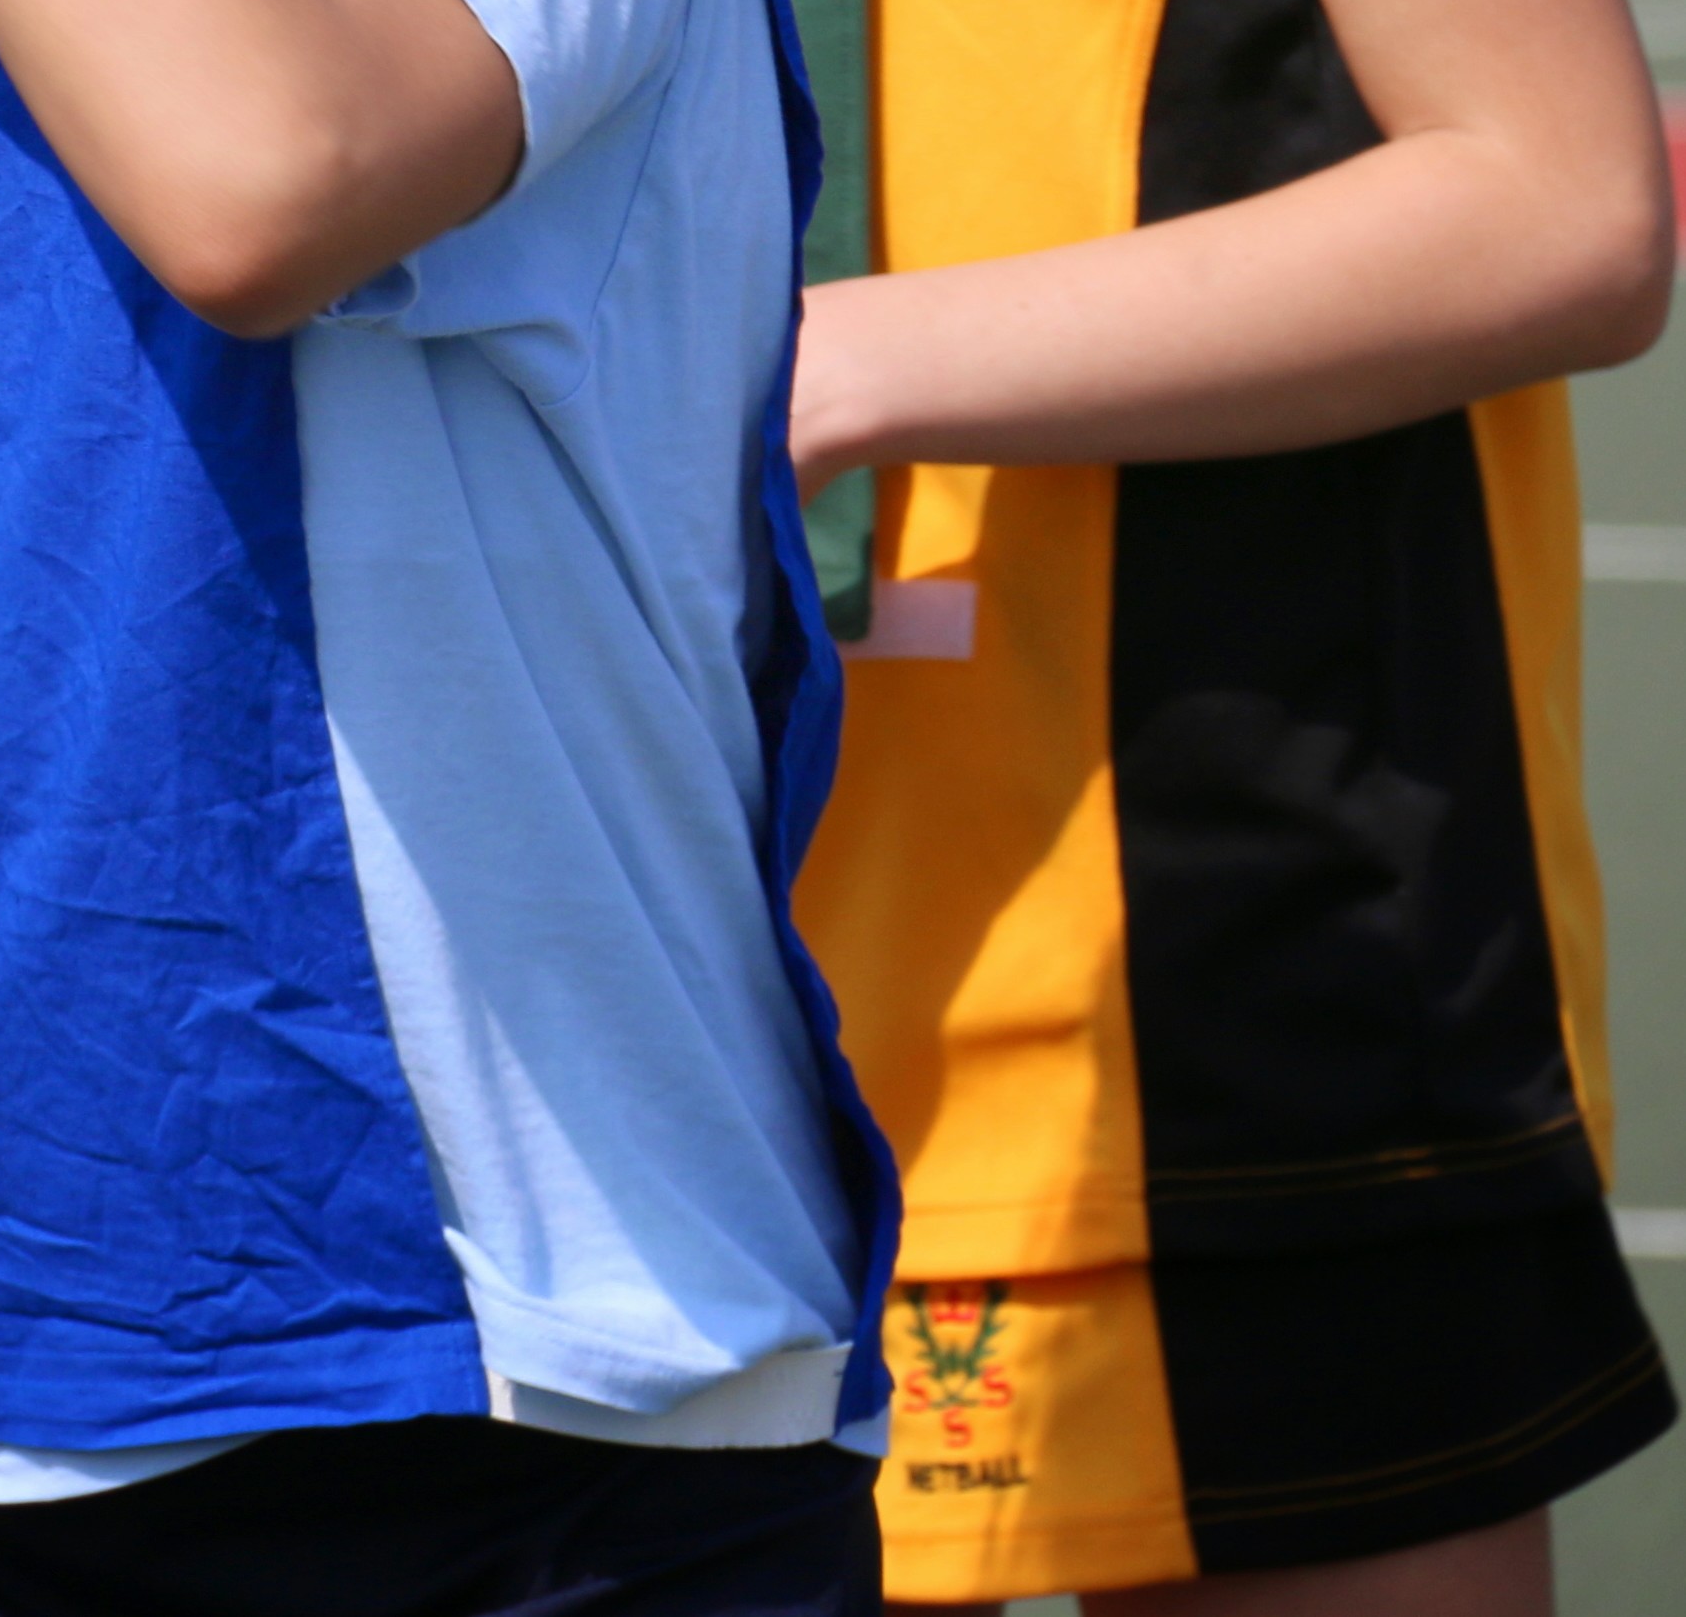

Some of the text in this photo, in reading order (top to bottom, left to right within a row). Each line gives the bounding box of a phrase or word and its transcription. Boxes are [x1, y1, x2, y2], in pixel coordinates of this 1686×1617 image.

[903, 1365, 1014, 1413] S S
[942, 1406, 973, 1449] S
[906, 1453, 1028, 1493] NETBALL
